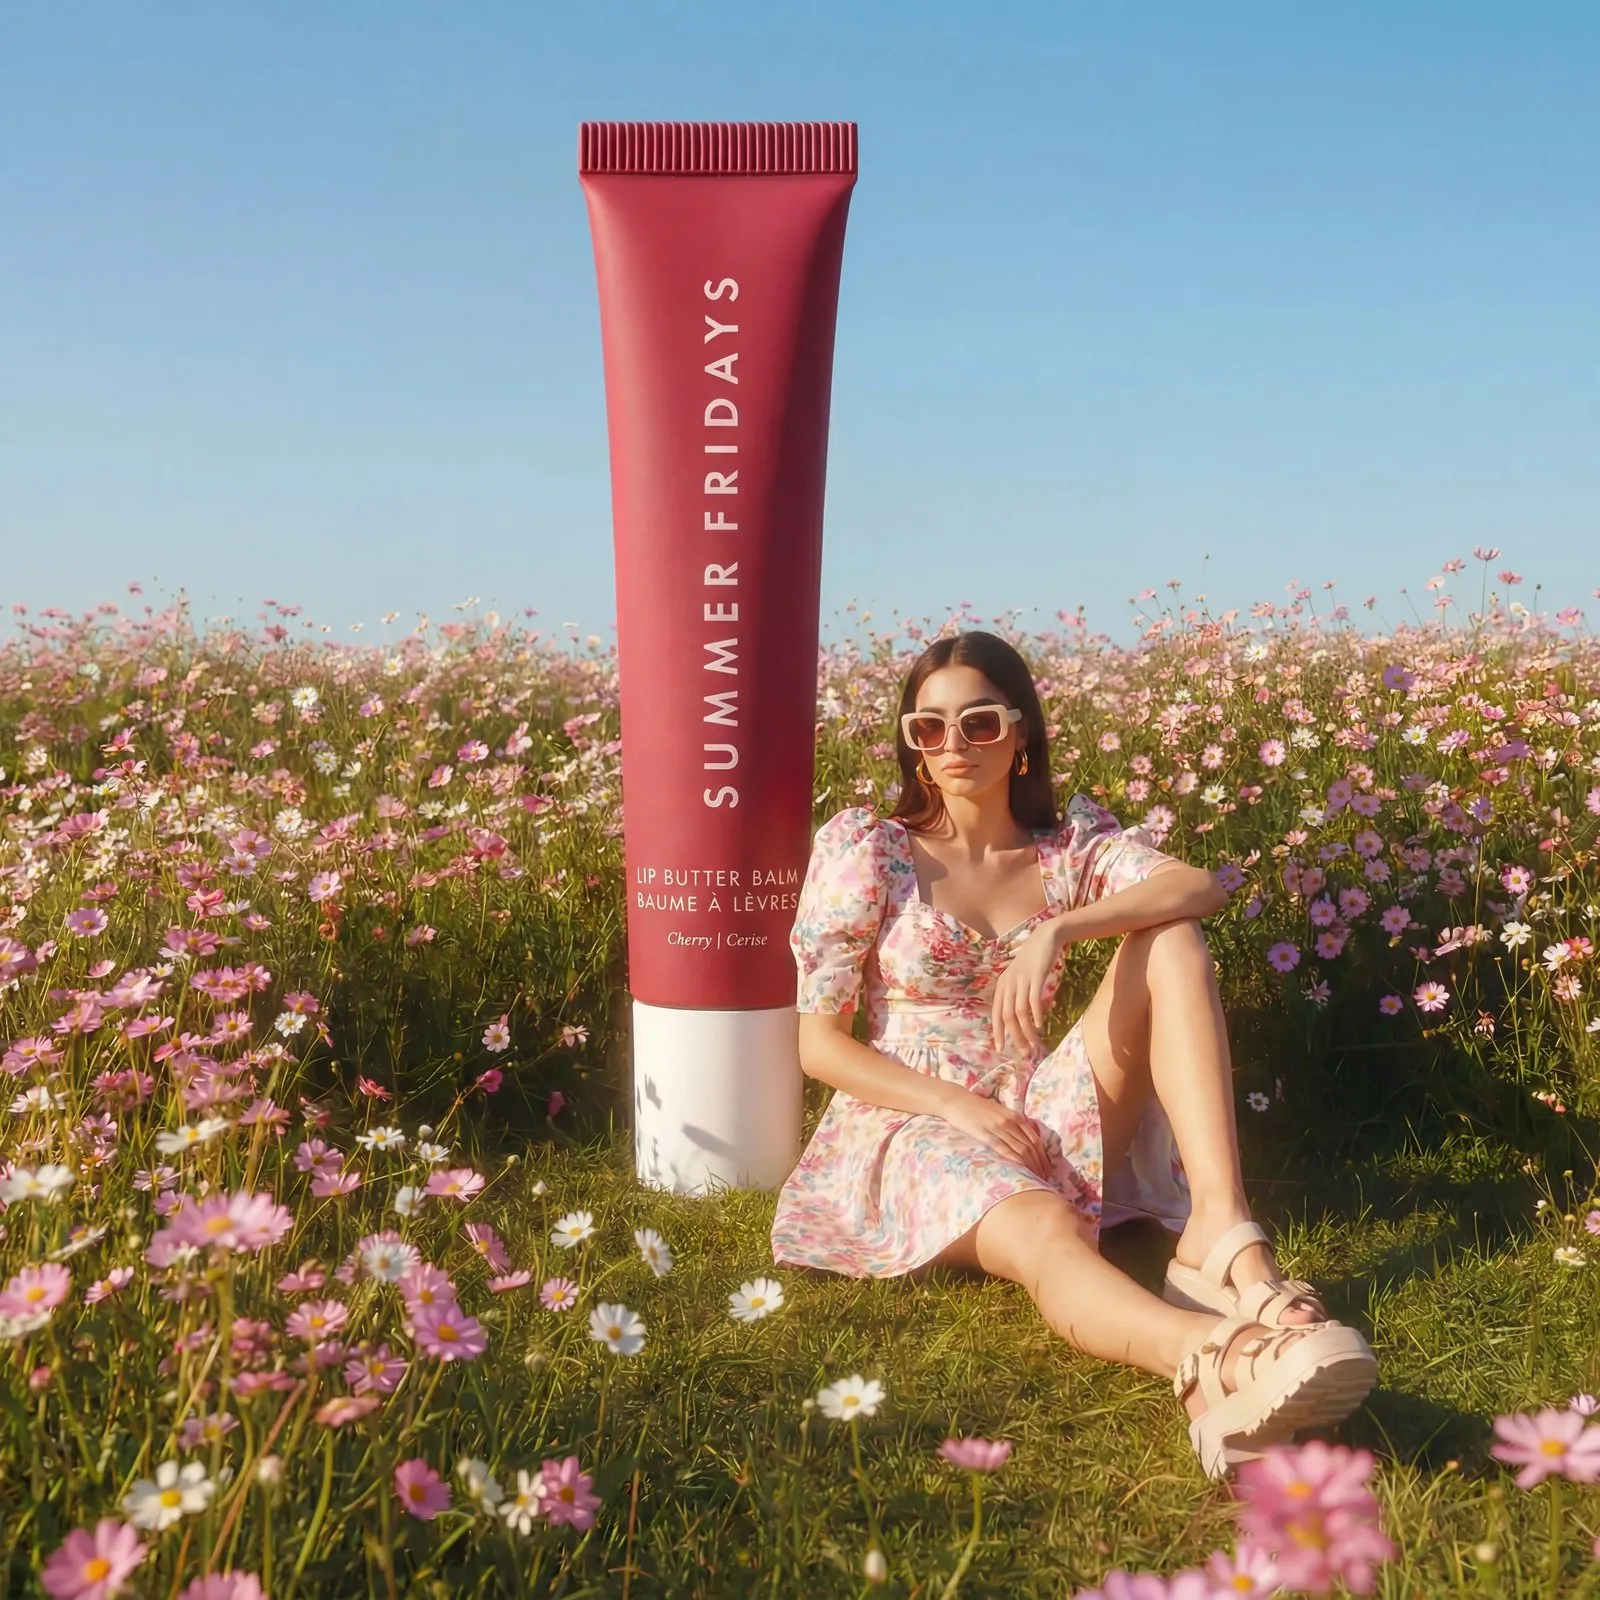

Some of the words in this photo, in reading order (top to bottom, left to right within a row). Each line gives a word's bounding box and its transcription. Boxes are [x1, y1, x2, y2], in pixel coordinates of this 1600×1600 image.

[704, 277, 739, 531] FRIDAYS
[703, 561, 739, 809] SUMMER
[636, 867, 656, 884] LIP
[664, 870, 740, 887] BUTTER
[752, 868, 798, 886] BALM
[637, 891, 697, 912] BAUME
[708, 891, 722, 912] À
[733, 891, 797, 912] LÈVRES
[667, 931, 713, 950] Cherry
[726, 932, 768, 947] Cerise
